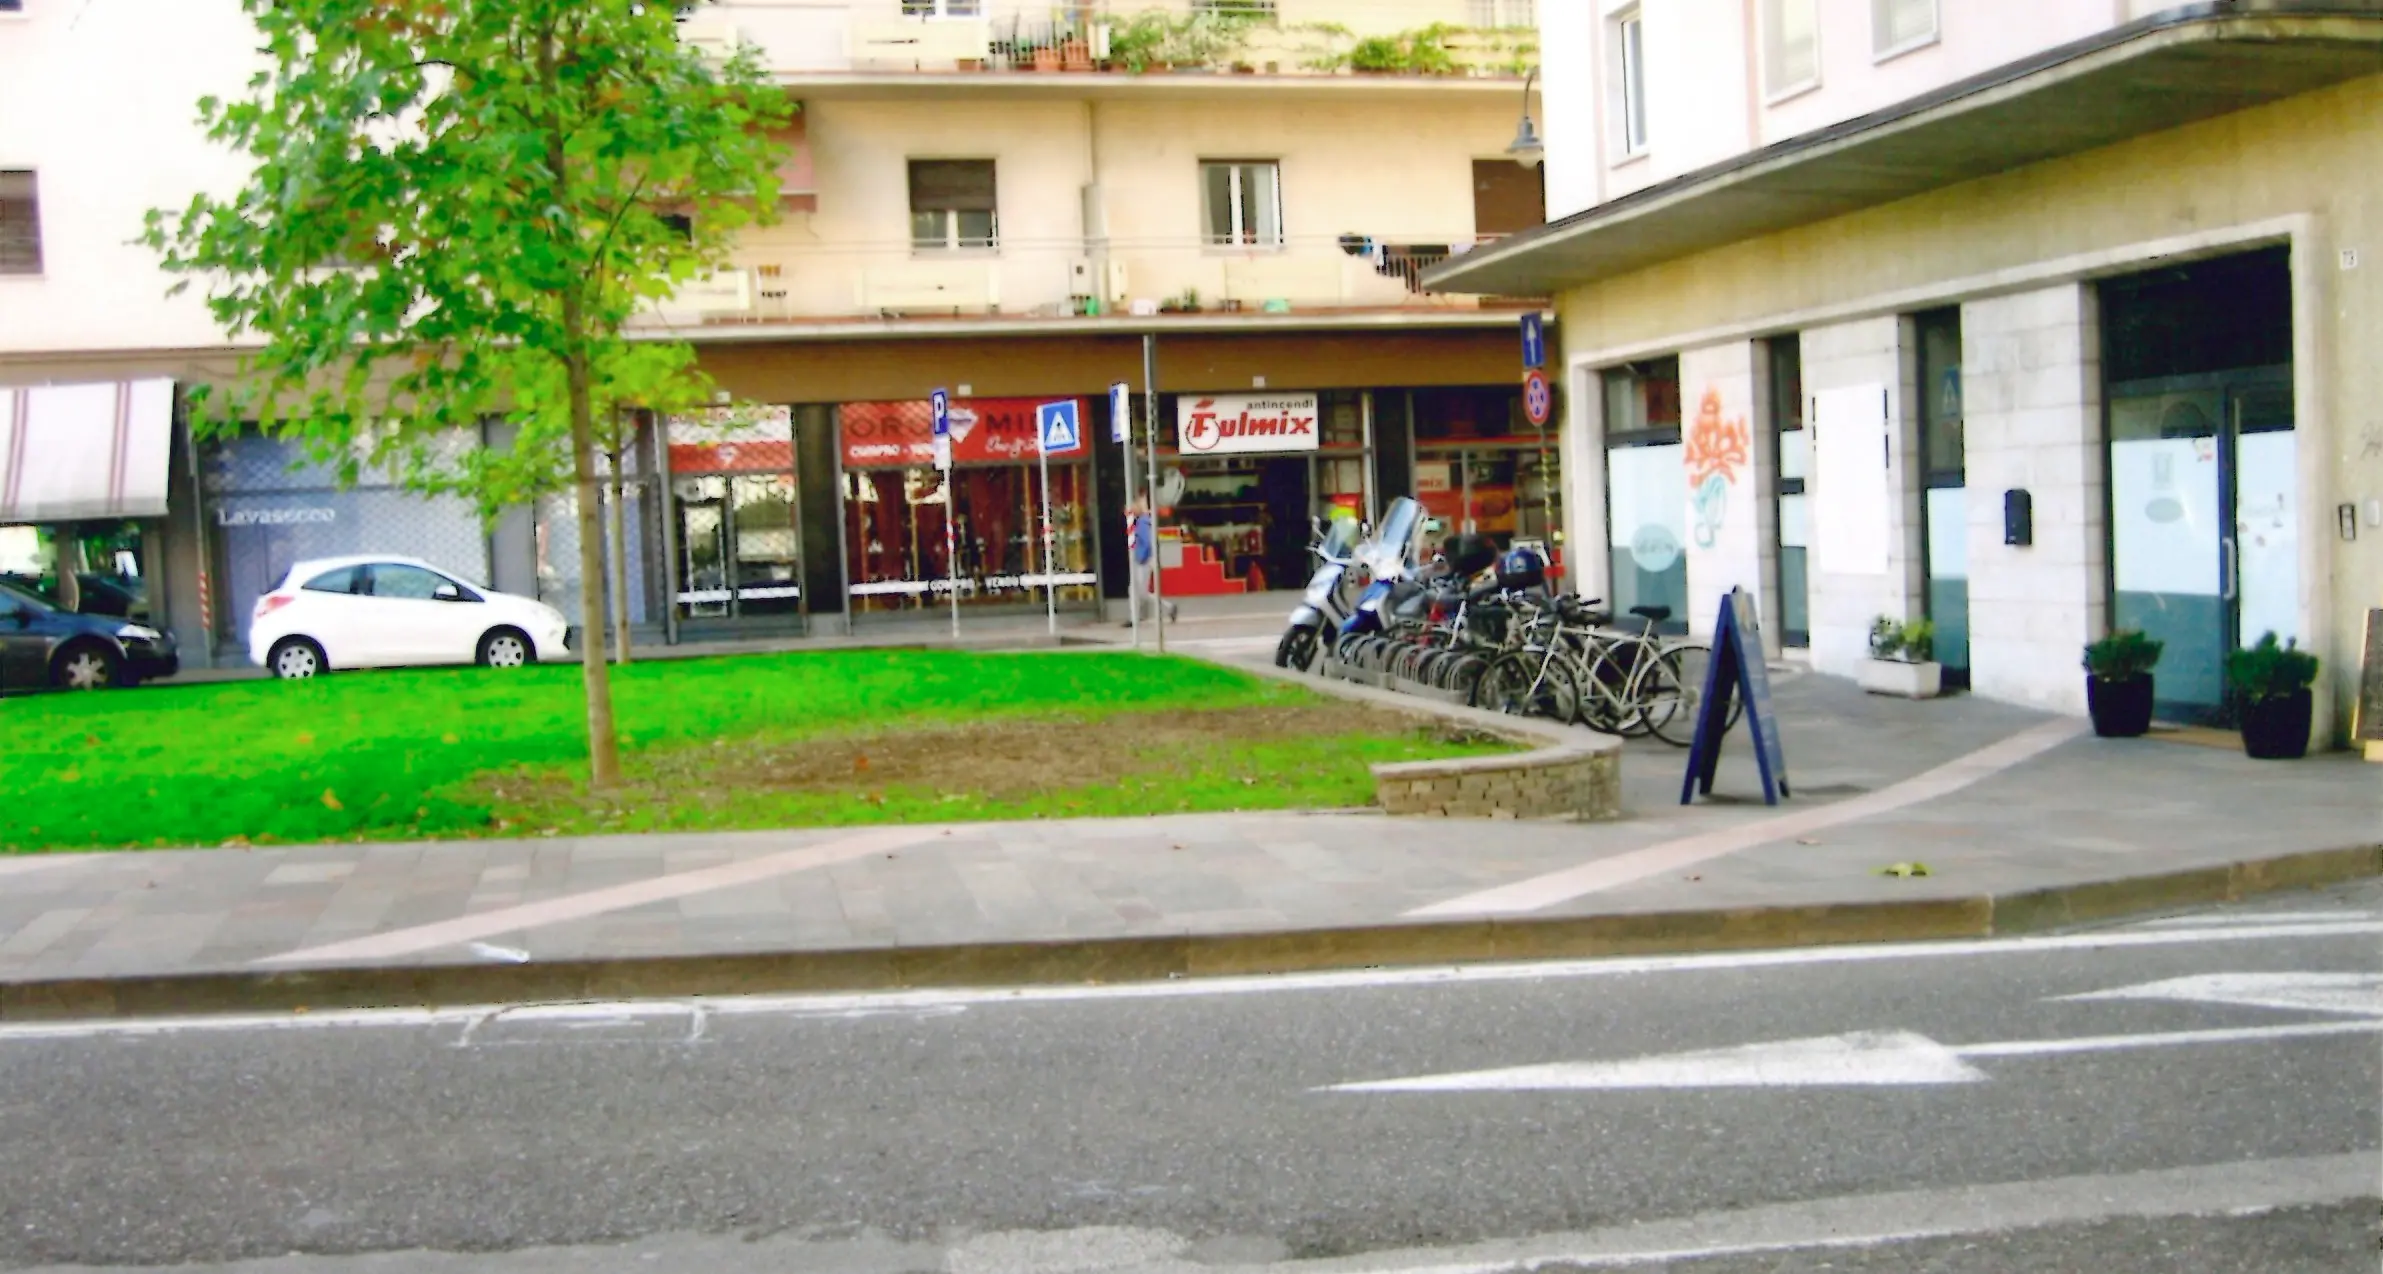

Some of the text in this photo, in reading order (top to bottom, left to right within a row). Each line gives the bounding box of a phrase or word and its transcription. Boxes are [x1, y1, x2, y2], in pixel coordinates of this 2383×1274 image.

[933, 393, 945, 432] P
[1247, 399, 1313, 411] antincendi
[1190, 408, 1313, 438] Fulmix
[216, 507, 336, 526] Lavasecco
